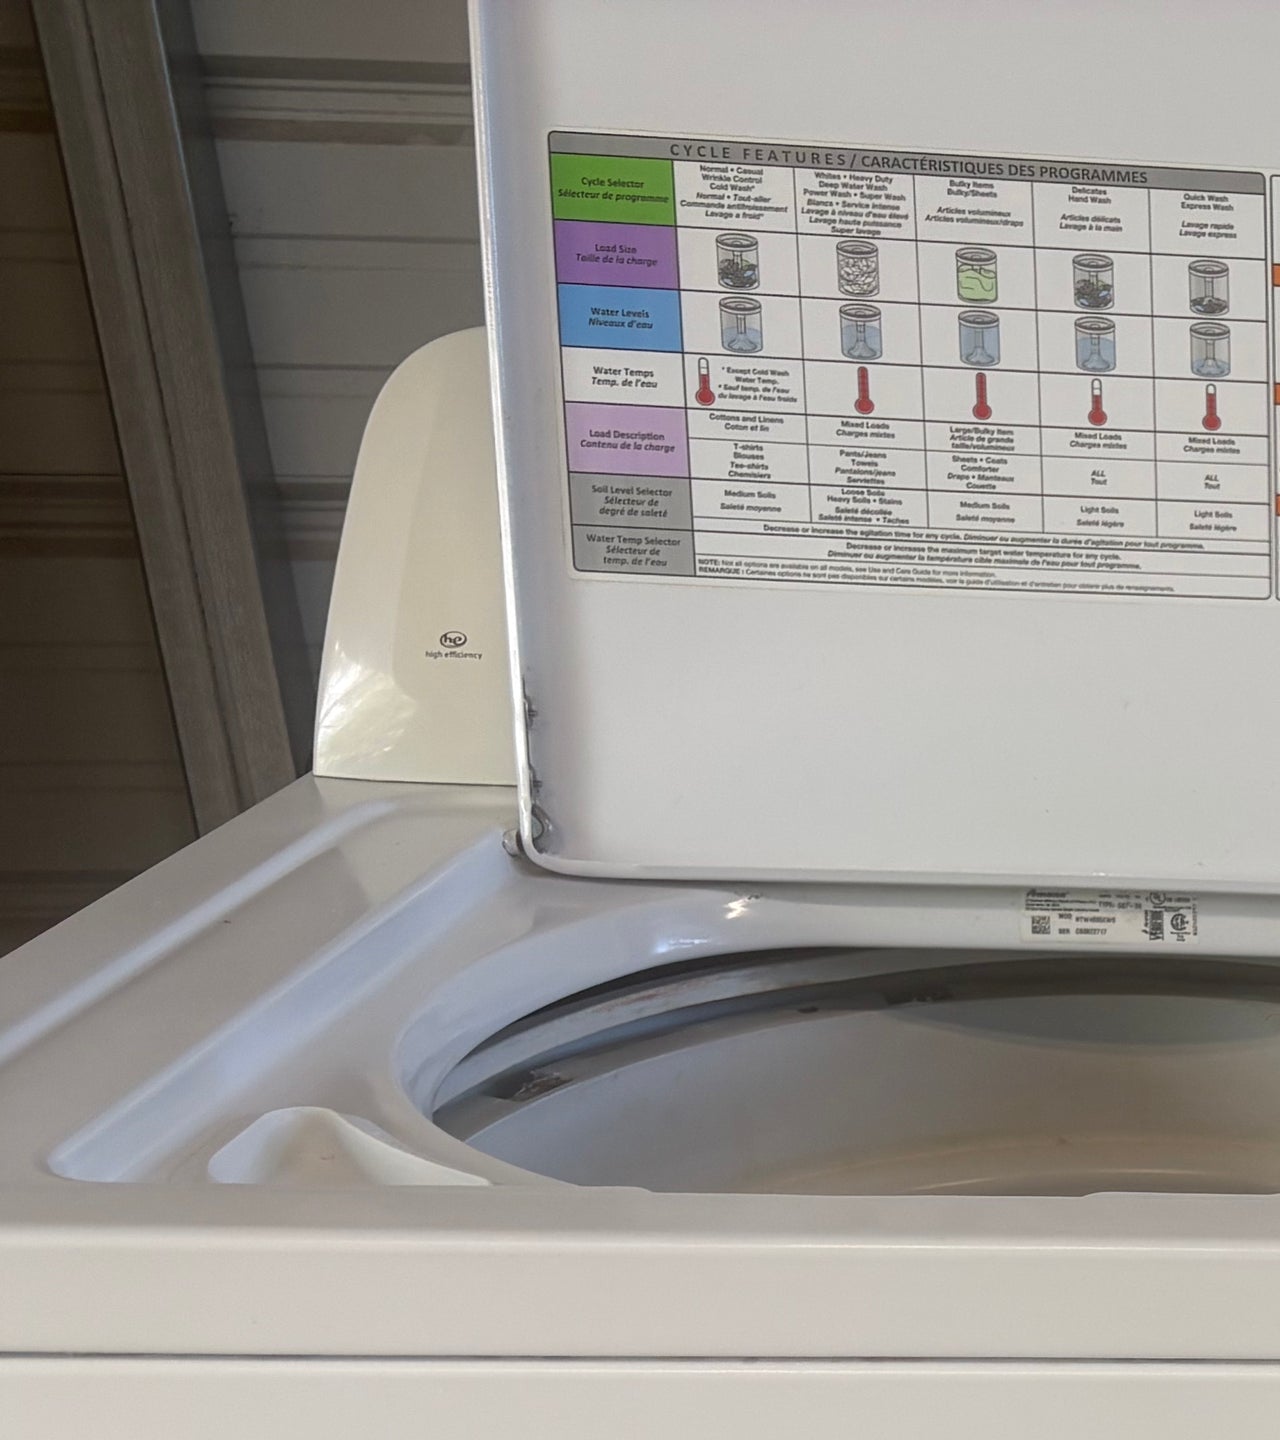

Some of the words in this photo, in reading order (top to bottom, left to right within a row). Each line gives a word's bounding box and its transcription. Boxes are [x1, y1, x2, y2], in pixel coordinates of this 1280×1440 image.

[670, 143, 731, 159] CYCLE
[861, 155, 1004, 176] CARACTÉRISTIQUES
[1008, 165, 1035, 177] DES
[1039, 165, 1148, 184] PROGRAMMES
[581, 177, 606, 189] Cycle
[607, 178, 645, 189] Selector
[558, 188, 600, 200] Sélecteur
[601, 191, 613, 200] de
[615, 192, 669, 204] programme
[1071, 186, 1107, 196] Delicates
[1183, 193, 1206, 202] Quick
[1207, 194, 1229, 203] Wash
[1180, 201, 1212, 211] Express
[1212, 203, 1234, 212] Wash
[594, 243, 617, 254] Load
[618, 244, 637, 254] Size
[576, 253, 601, 263] Taille
[602, 254, 614, 264] de
[615, 255, 625, 265] la
[626, 257, 658, 267] charge
[590, 307, 619, 317] Water
[620, 309, 650, 319] Levels
[588, 318, 626, 328] Niveaux
[593, 366, 622, 376] Water
[623, 368, 654, 379] Temps
[591, 377, 620, 387] Temp.
[621, 378, 634, 387] de
[709, 412, 741, 423] Cottons
[744, 414, 757, 423] and
[758, 415, 784, 424] Linens
[589, 429, 612, 439] Load
[612, 430, 665, 442] Description
[580, 439, 620, 450] Contenu
[620, 441, 632, 451] de
[633, 441, 643, 451] la
[644, 443, 676, 454] charge
[591, 485, 610, 495] Soil
[610, 486, 634, 496] Level
[635, 487, 673, 497] Selector
[603, 496, 646, 507] Sélecteur
[647, 497, 660, 507] de
[598, 506, 625, 517] degré
[626, 508, 639, 517] de
[640, 508, 668, 518] saleté
[586, 533, 616, 544] Water
[617, 535, 642, 546] Temp
[644, 536, 681, 547] Selector
[605, 545, 647, 556] Sélecteur
[649, 547, 661, 556] de
[603, 556, 629, 567] temp.
[631, 557, 643, 567] de
[425, 650, 443, 659] high
[444, 651, 483, 660] efficiency
